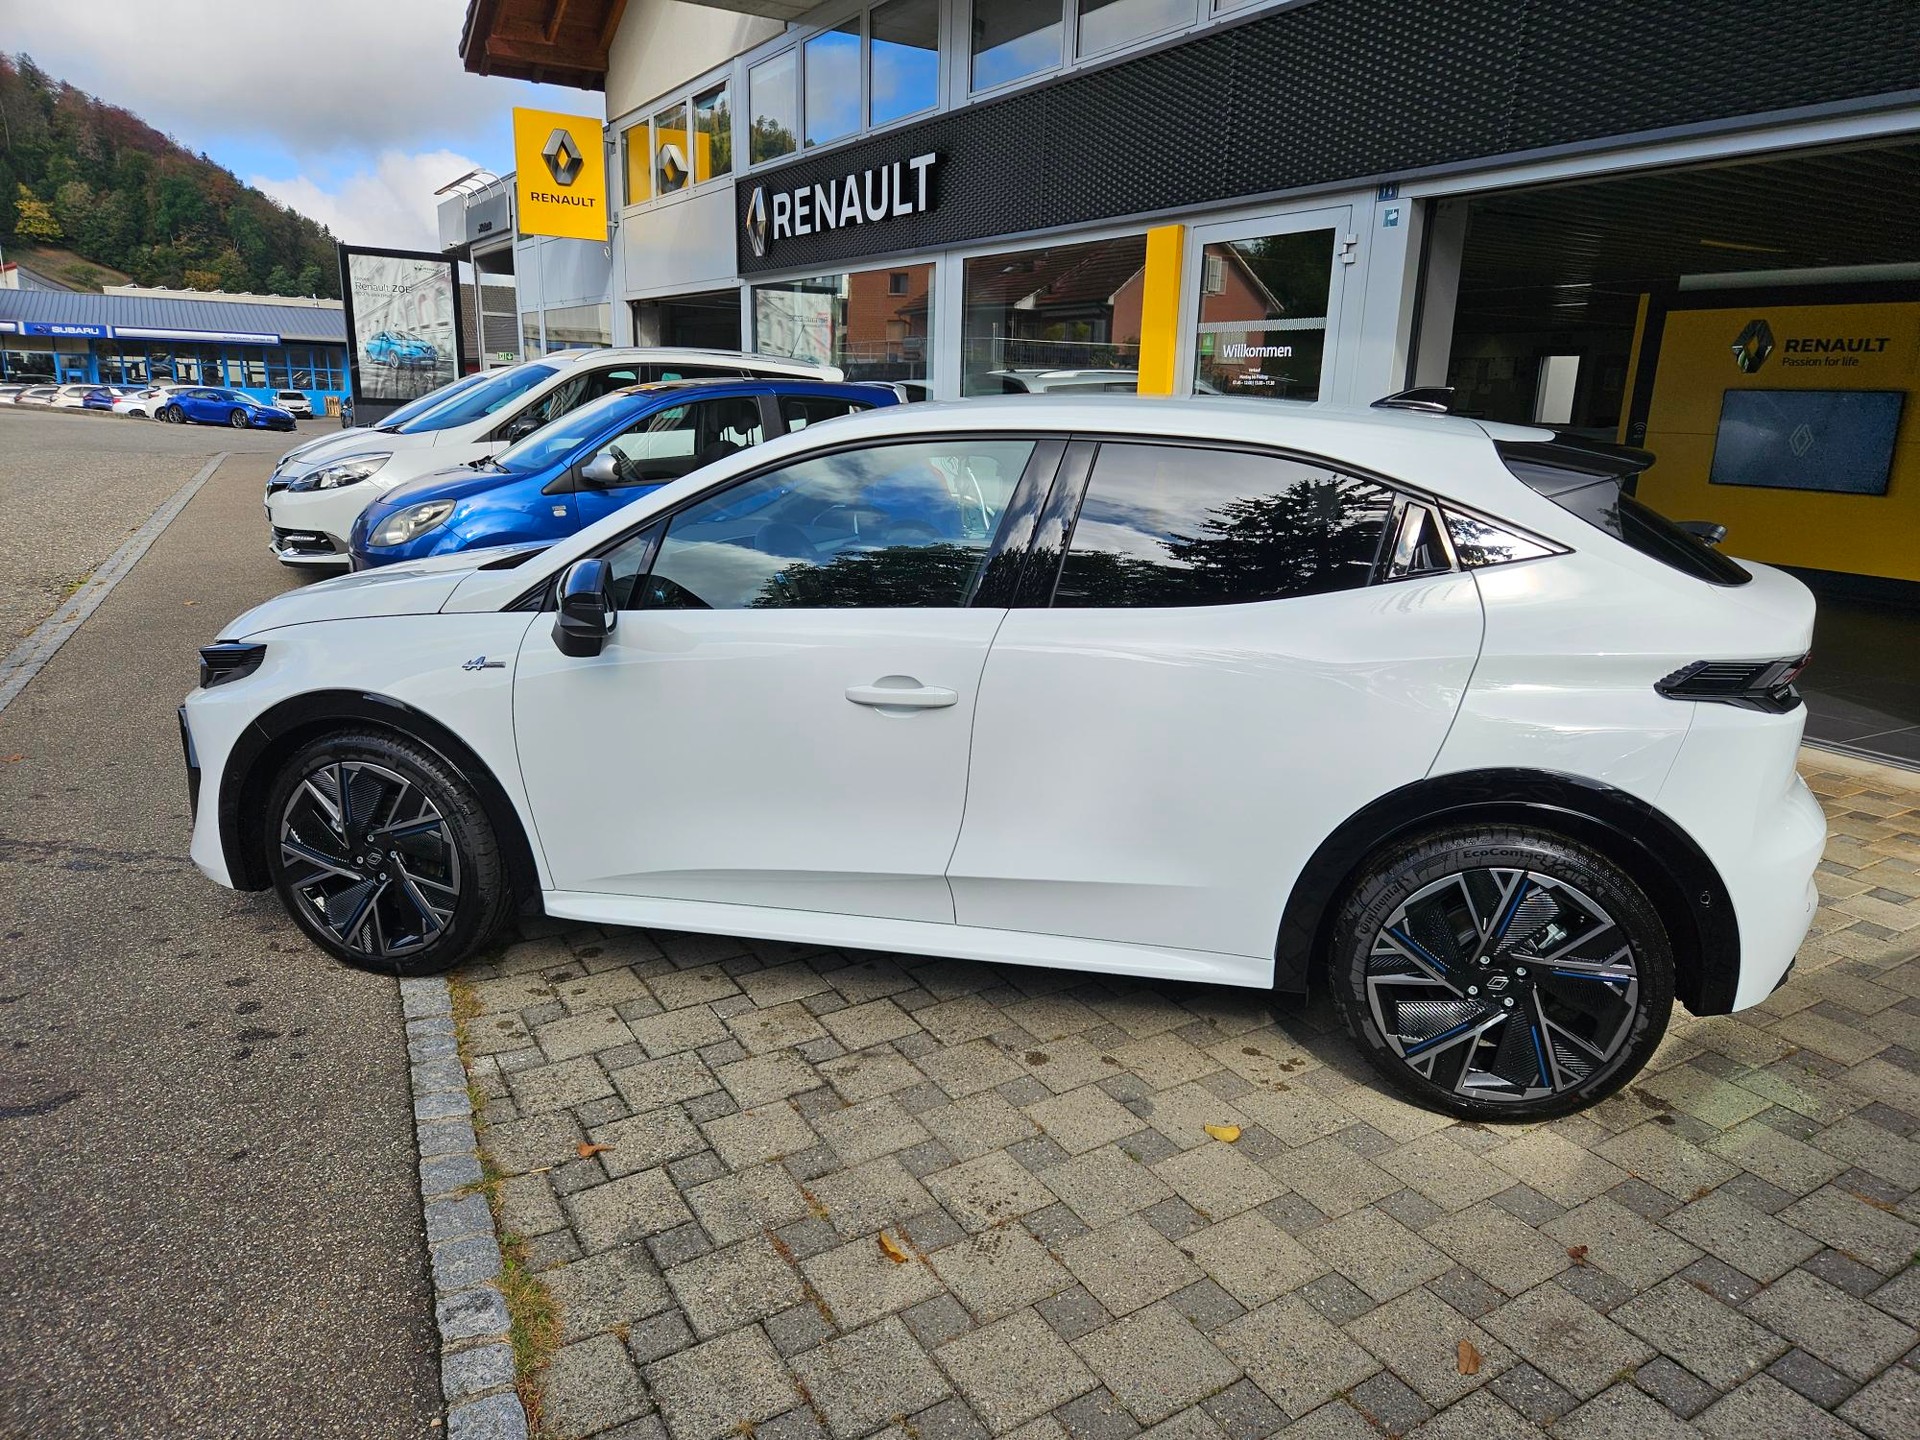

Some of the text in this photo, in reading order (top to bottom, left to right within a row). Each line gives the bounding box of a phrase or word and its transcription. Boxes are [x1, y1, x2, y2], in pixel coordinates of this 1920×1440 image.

[530, 192, 596, 207] RENAULT
[772, 152, 936, 240] RENAULT
[355, 281, 389, 292] Renault
[392, 285, 412, 294] ZOE
[51, 326, 99, 334] SUBARU
[1223, 343, 1292, 358] Willkommen
[1784, 338, 1891, 353] RENAULT
[1782, 356, 1859, 367] Passion for life
[1463, 847, 1549, 862] EcoContact
